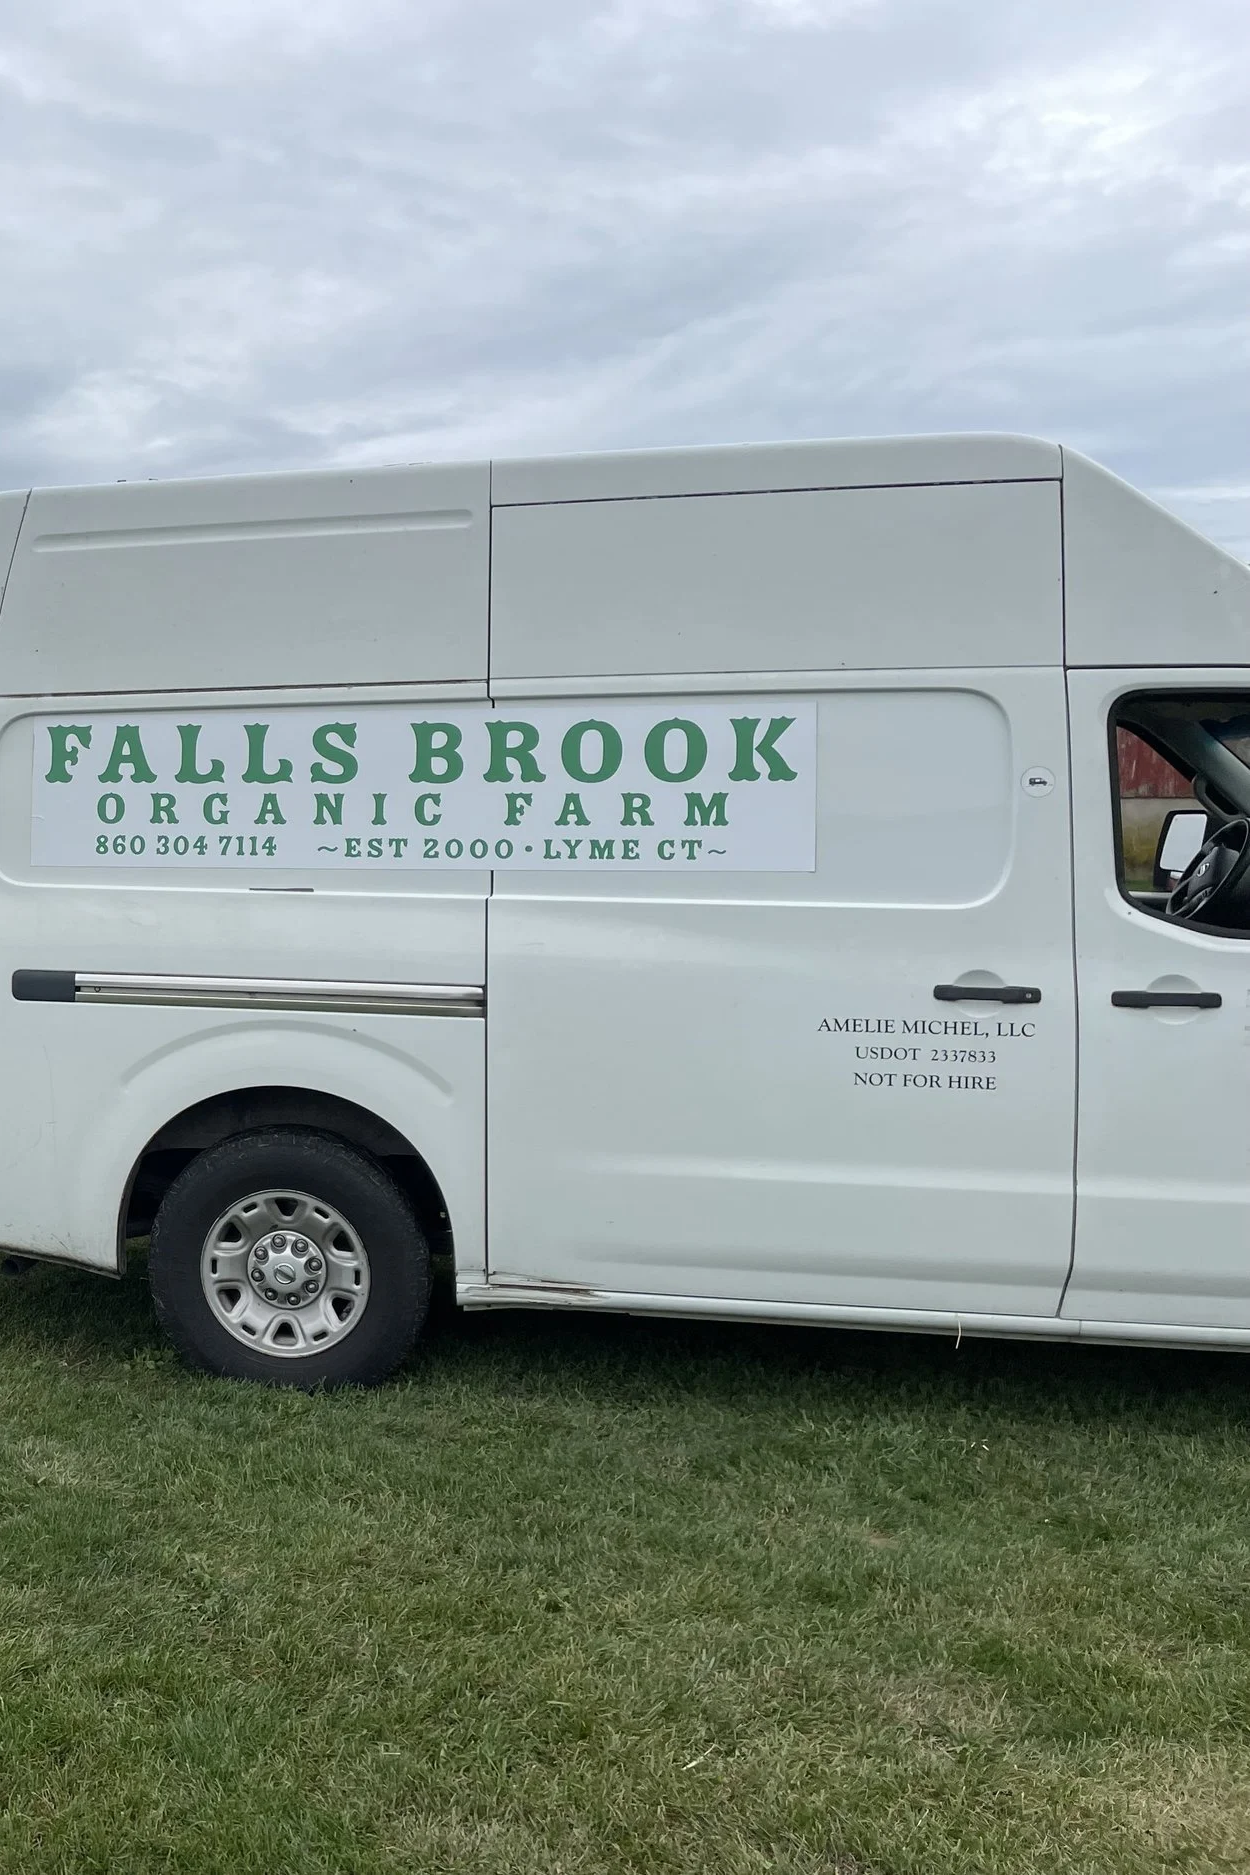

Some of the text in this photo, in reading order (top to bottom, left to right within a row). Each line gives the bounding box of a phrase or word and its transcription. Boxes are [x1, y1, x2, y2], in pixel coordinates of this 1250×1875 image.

[45, 716, 799, 785] FALLS BROOK
[96, 790, 731, 827] ORGANIC FARM
[96, 835, 277, 857] 860 304 7114
[817, 1018, 1036, 1039] AMELIE MICHEL, LLC
[854, 1046, 996, 1063] USDOT 2337833
[853, 1072, 997, 1091] NOT FOR HIRE
